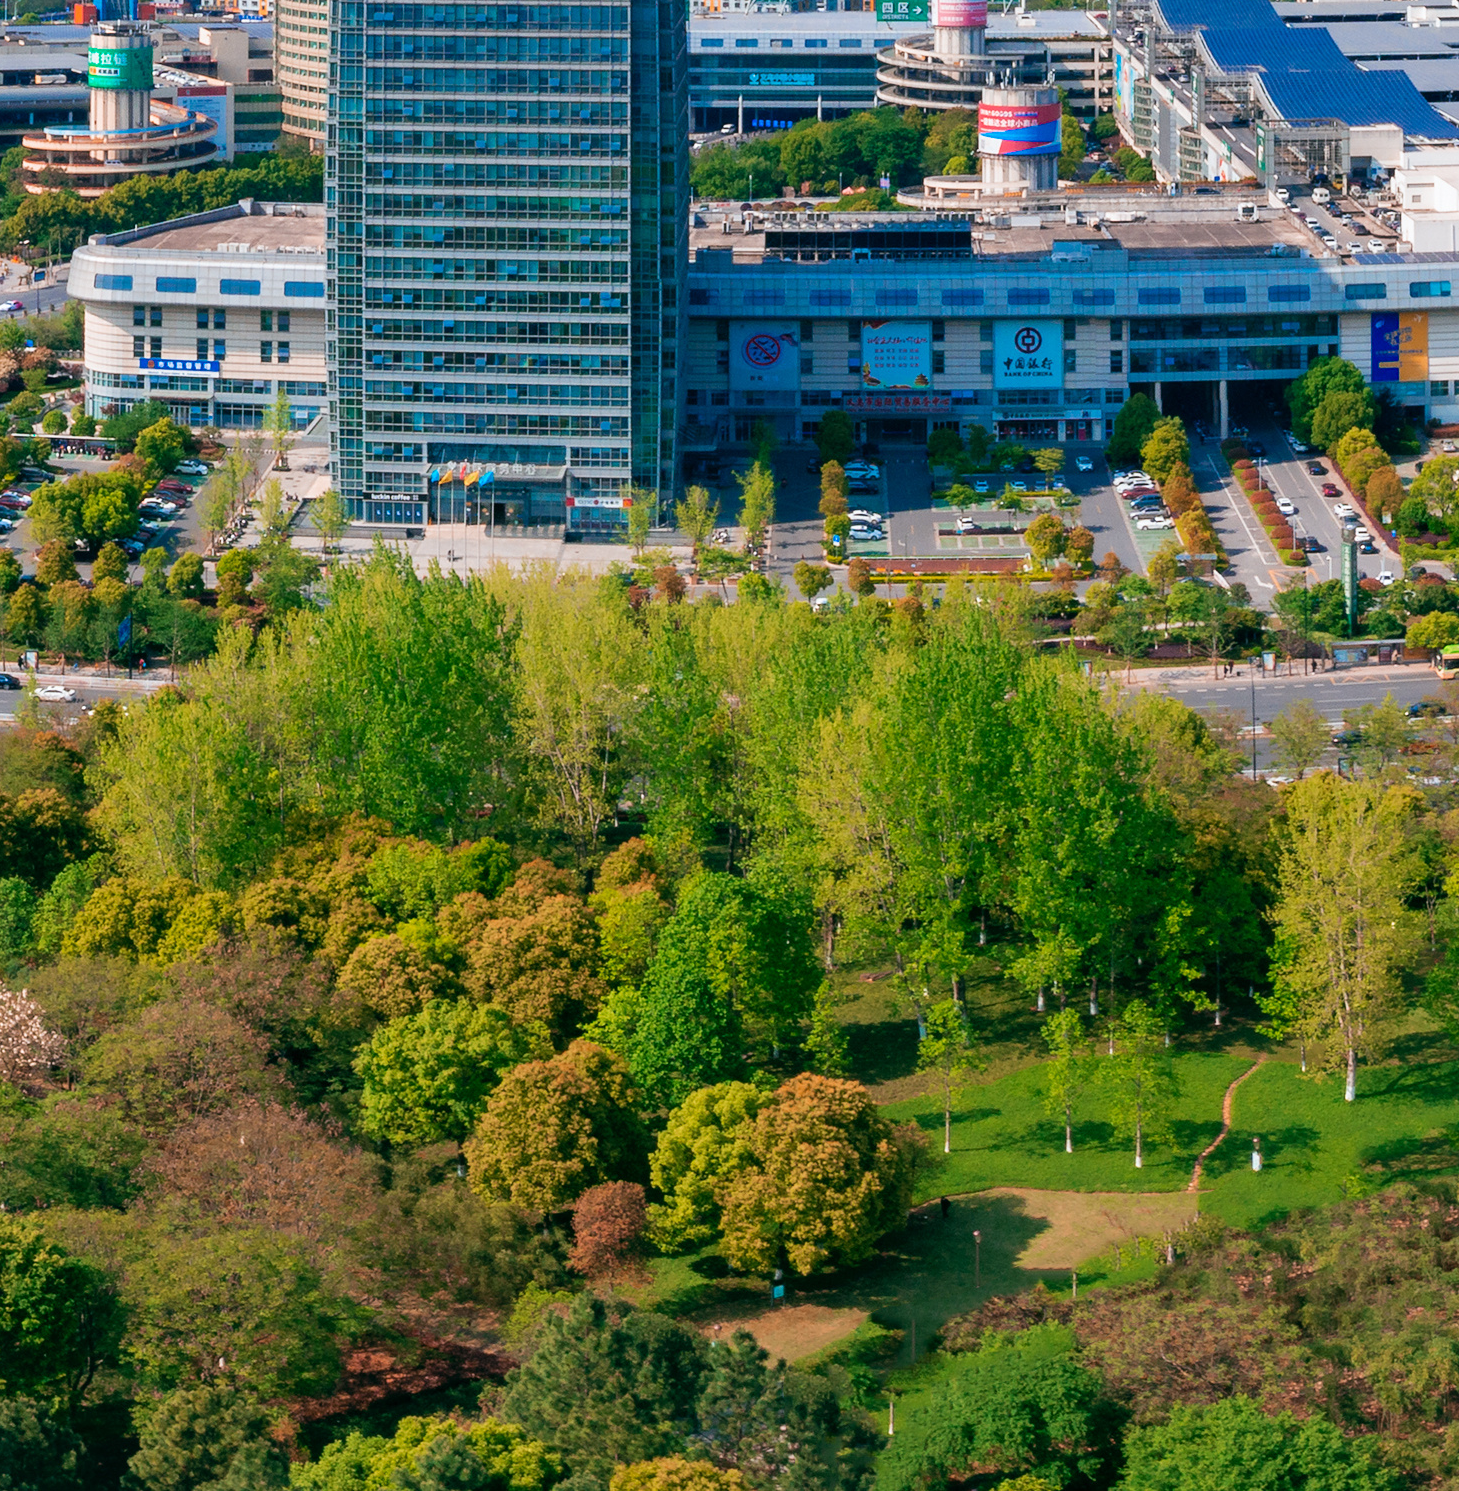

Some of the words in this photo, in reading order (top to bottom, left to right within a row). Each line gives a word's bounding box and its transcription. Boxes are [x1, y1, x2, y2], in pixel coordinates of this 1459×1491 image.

[882, 2, 909, 13] 四区
[1003, 357, 1054, 371] 中国银行
